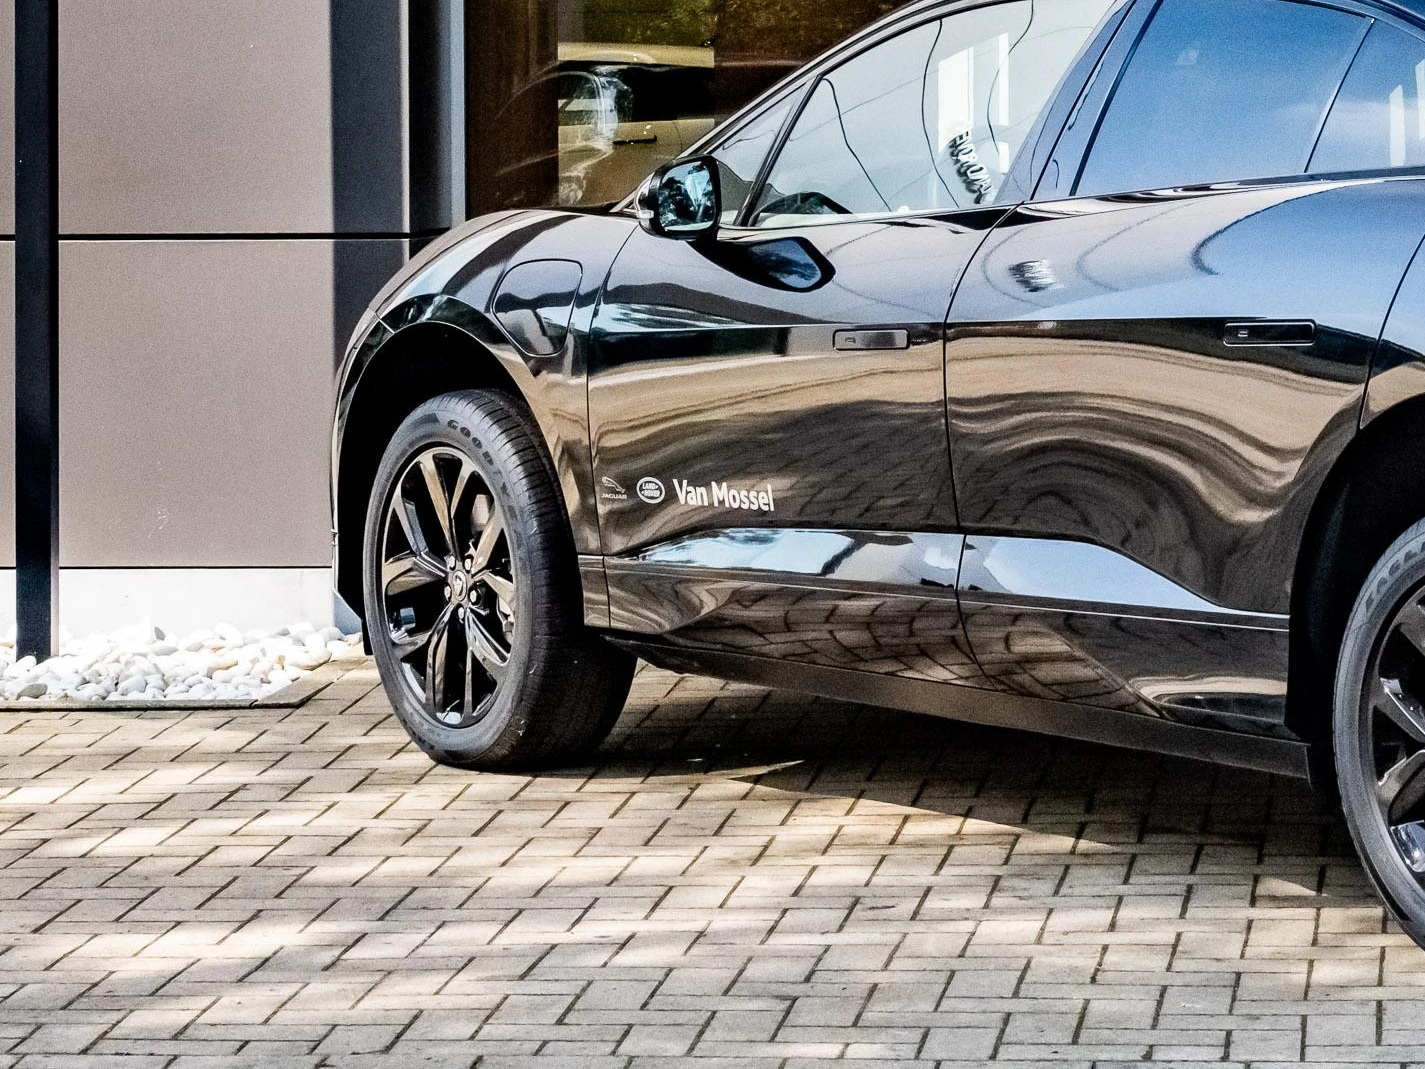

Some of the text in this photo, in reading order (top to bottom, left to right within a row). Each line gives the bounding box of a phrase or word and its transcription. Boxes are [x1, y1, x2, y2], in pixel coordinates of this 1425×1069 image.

[642, 482, 655, 490] LAND
[673, 479, 775, 511] Van Mossel
